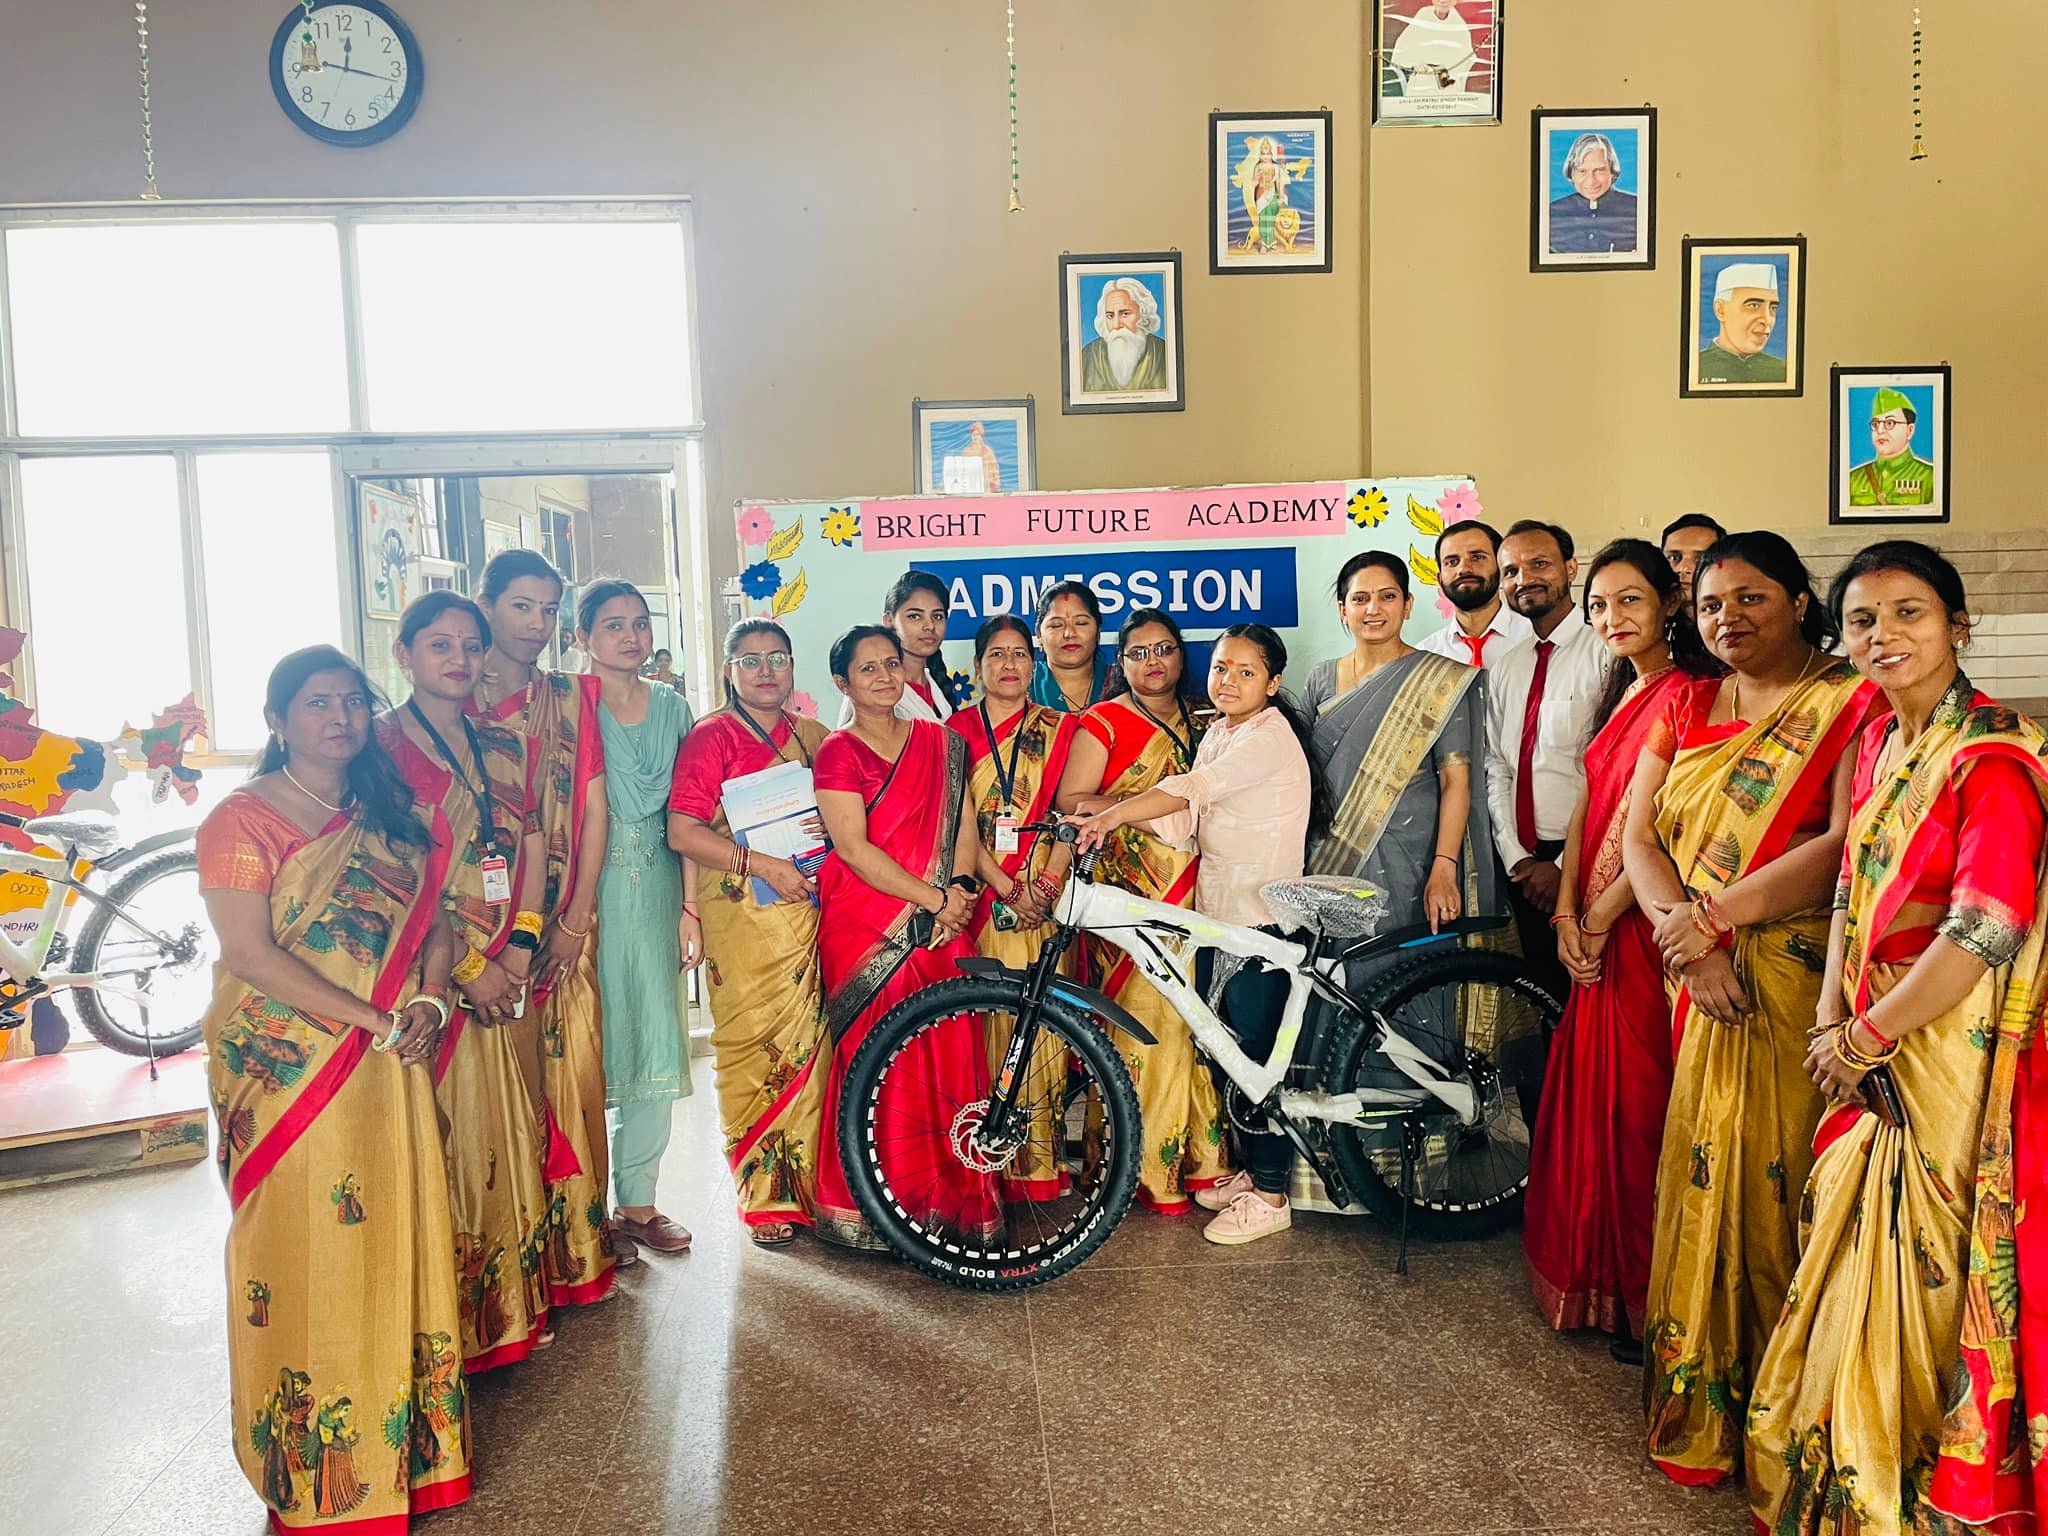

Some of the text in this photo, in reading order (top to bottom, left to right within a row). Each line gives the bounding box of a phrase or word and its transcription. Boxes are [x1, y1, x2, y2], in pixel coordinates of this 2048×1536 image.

[315, 22, 330, 39] 11
[335, 14, 353, 32] 12
[364, 20, 372, 37] 1
[380, 37, 392, 54] 2
[291, 62, 302, 79] 9
[390, 60, 401, 78] 3
[302, 86, 313, 103] 8
[383, 85, 395, 101] 4
[320, 102, 331, 119] 7
[344, 108, 356, 125] 6
[368, 102, 379, 119] 5
[876, 497, 1341, 539] BRIGHT FUTURE ACADEMY
[948, 569, 1263, 618] ADMSSION
[1514, 977, 1564, 1013] HARTEX
[959, 1206, 1105, 1279] HARTEX XTRA BOLD
